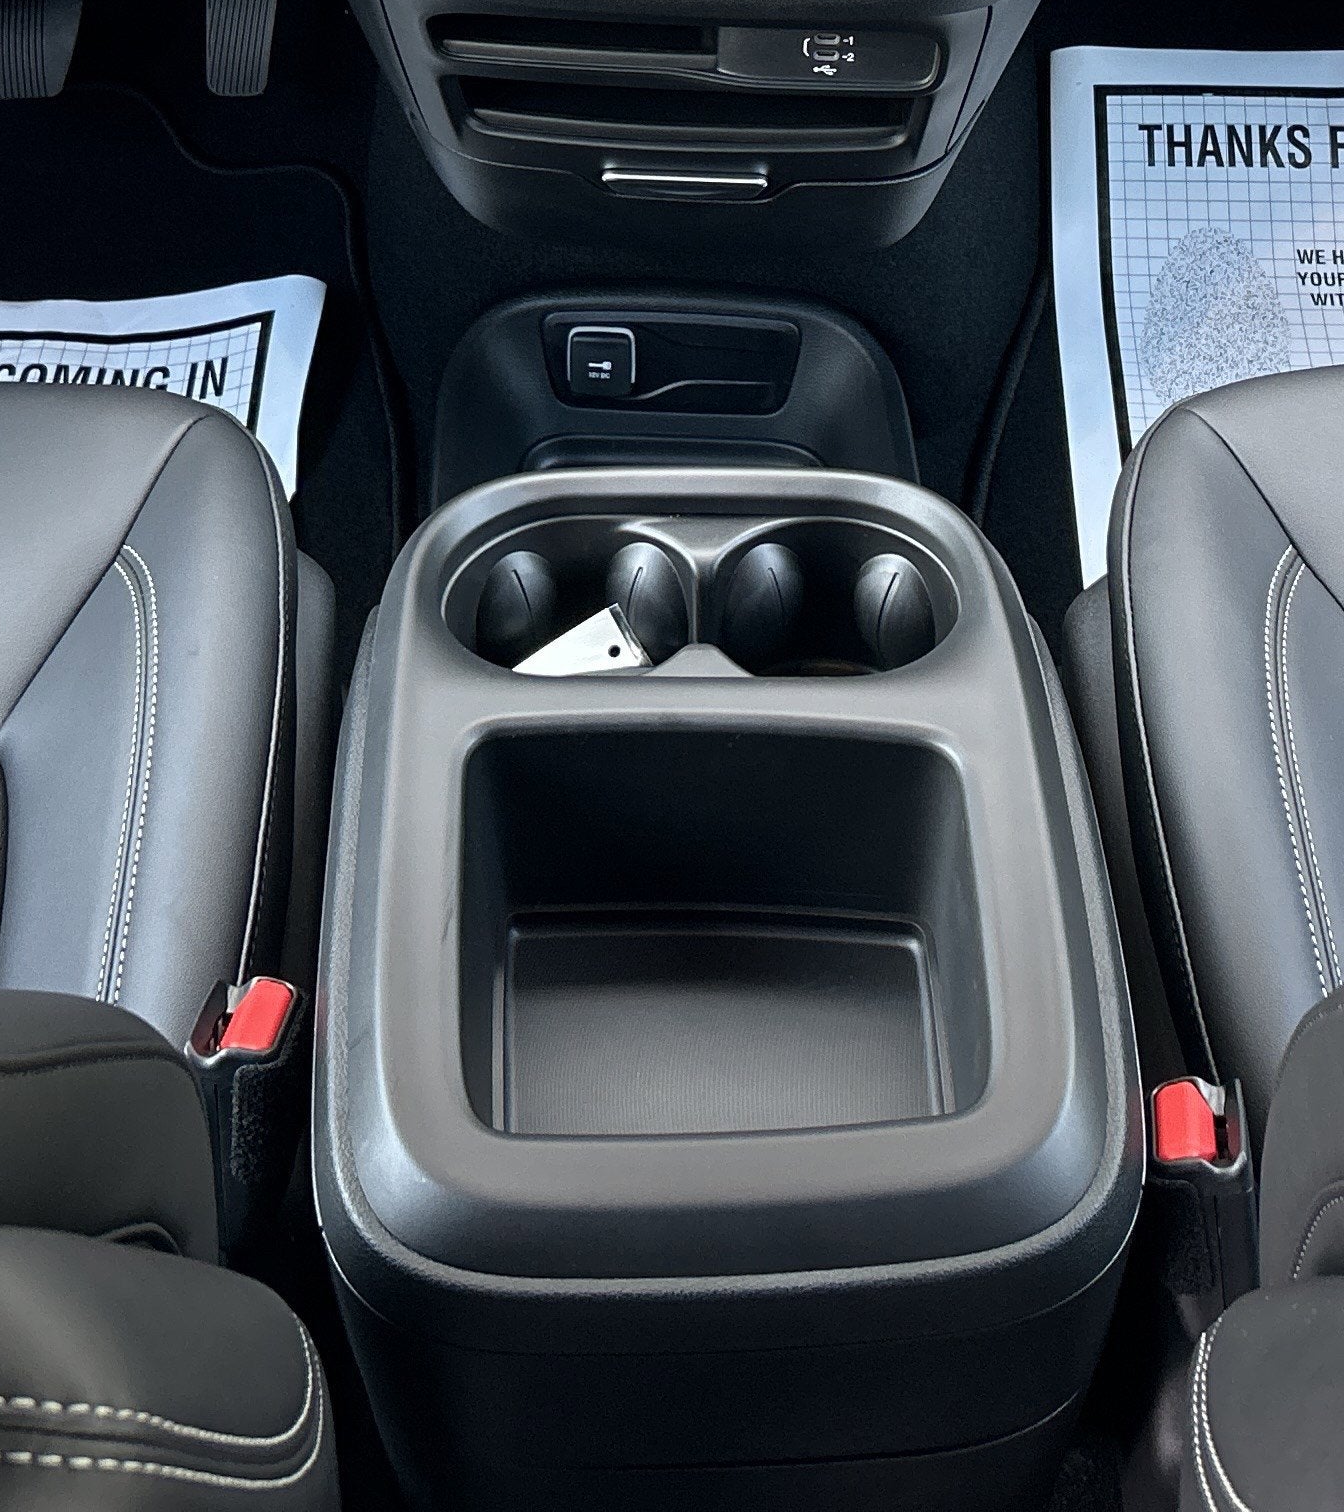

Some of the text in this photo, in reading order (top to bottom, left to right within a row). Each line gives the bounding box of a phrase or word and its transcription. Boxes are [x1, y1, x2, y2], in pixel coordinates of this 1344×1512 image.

[1137, 123, 1313, 170] THANKS
[1296, 248, 1326, 266] WE
[184, 356, 229, 400] IN
